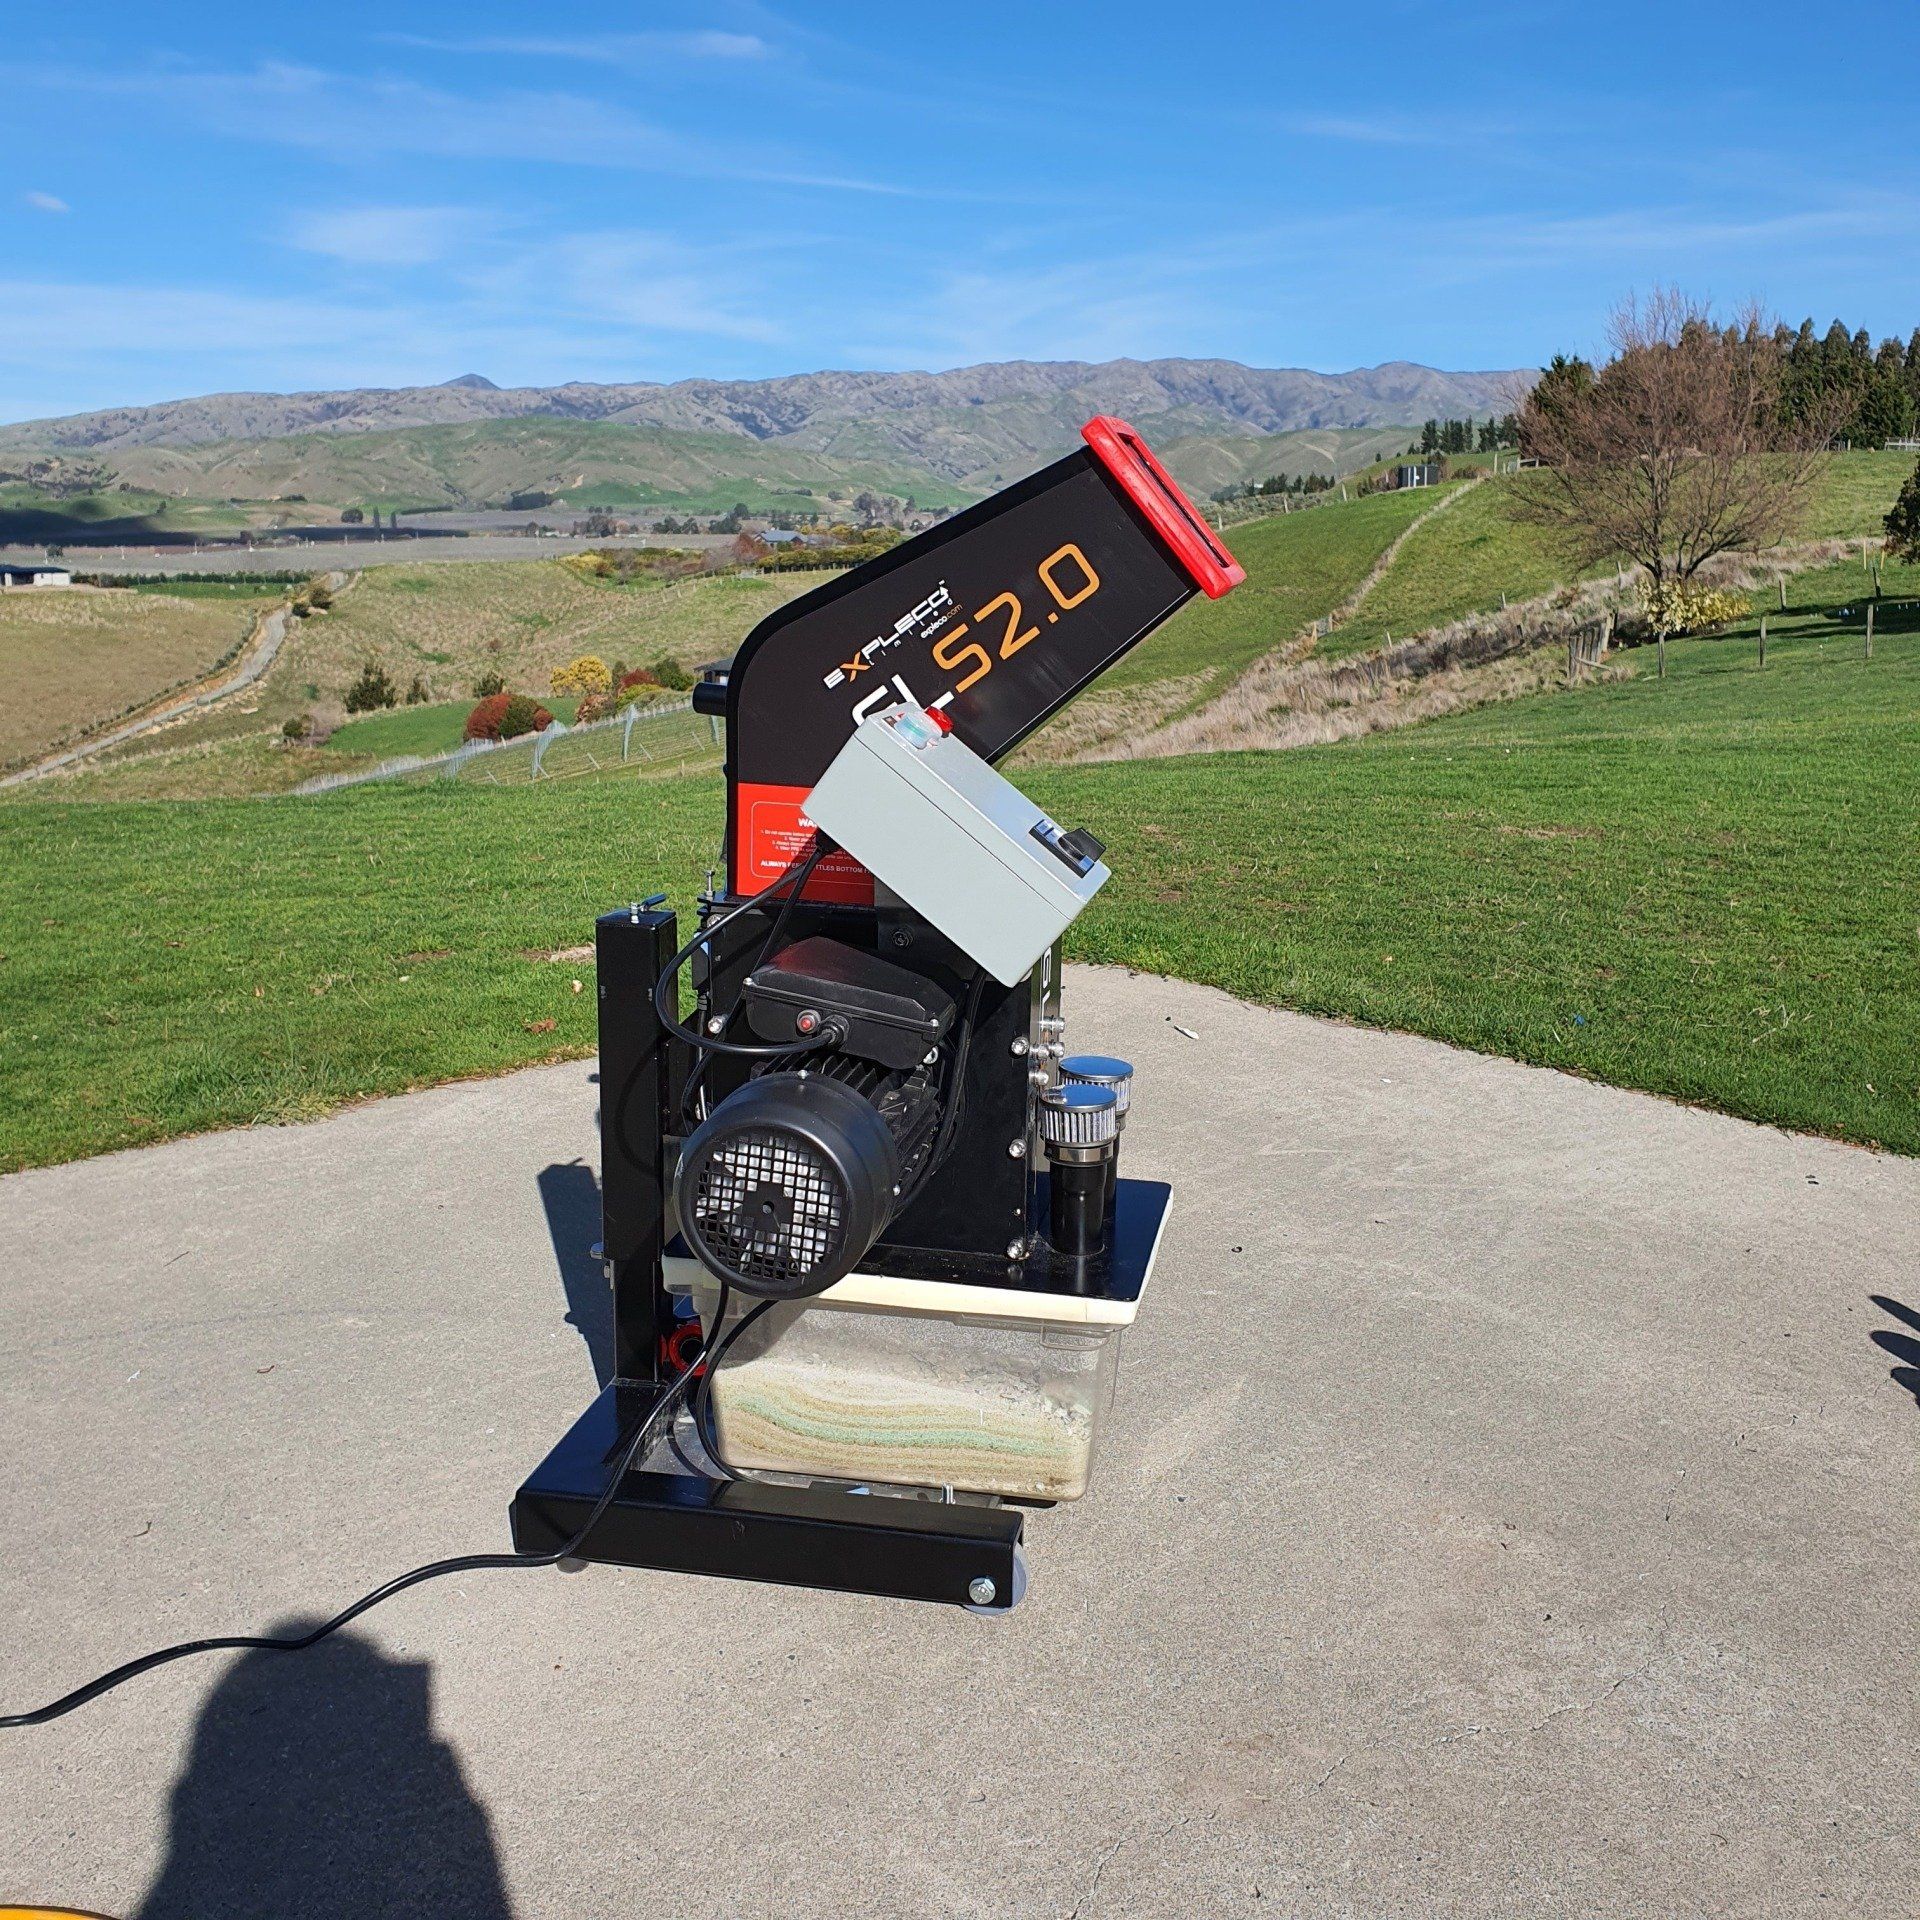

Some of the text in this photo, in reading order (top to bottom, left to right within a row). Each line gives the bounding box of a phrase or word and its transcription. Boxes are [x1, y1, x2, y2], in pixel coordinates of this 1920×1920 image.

[823, 586, 949, 689] EXPLECO
[920, 603, 964, 640] expleco.com
[760, 860, 787, 868] ALWAYS
[836, 865, 863, 874] BOTTOM
